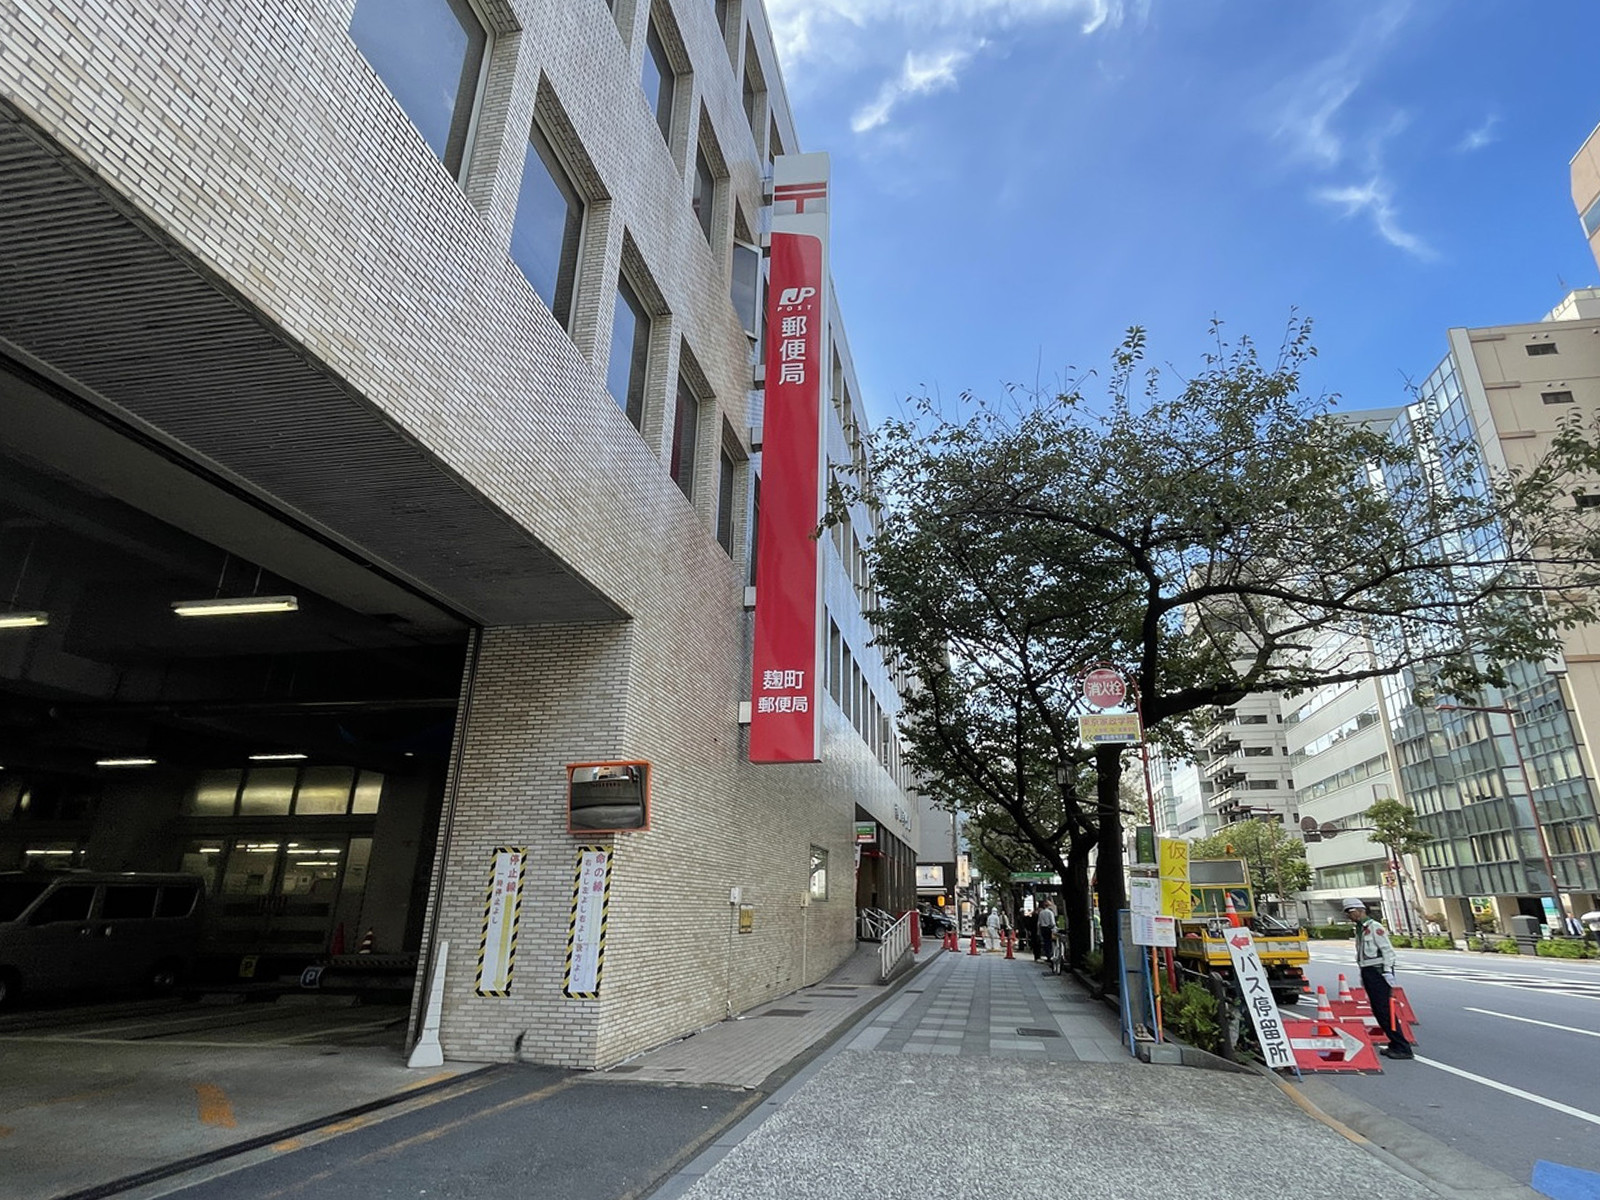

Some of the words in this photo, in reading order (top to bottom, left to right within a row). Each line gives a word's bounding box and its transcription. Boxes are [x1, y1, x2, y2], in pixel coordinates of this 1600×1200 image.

[779, 316, 807, 385] 郵便局
[763, 670, 805, 689] 麹町
[1087, 680, 1123, 697] 消火栓
[758, 696, 808, 713] 郵便局
[1167, 841, 1191, 919] 仮バス停
[1241, 952, 1289, 1064] バス停留所
